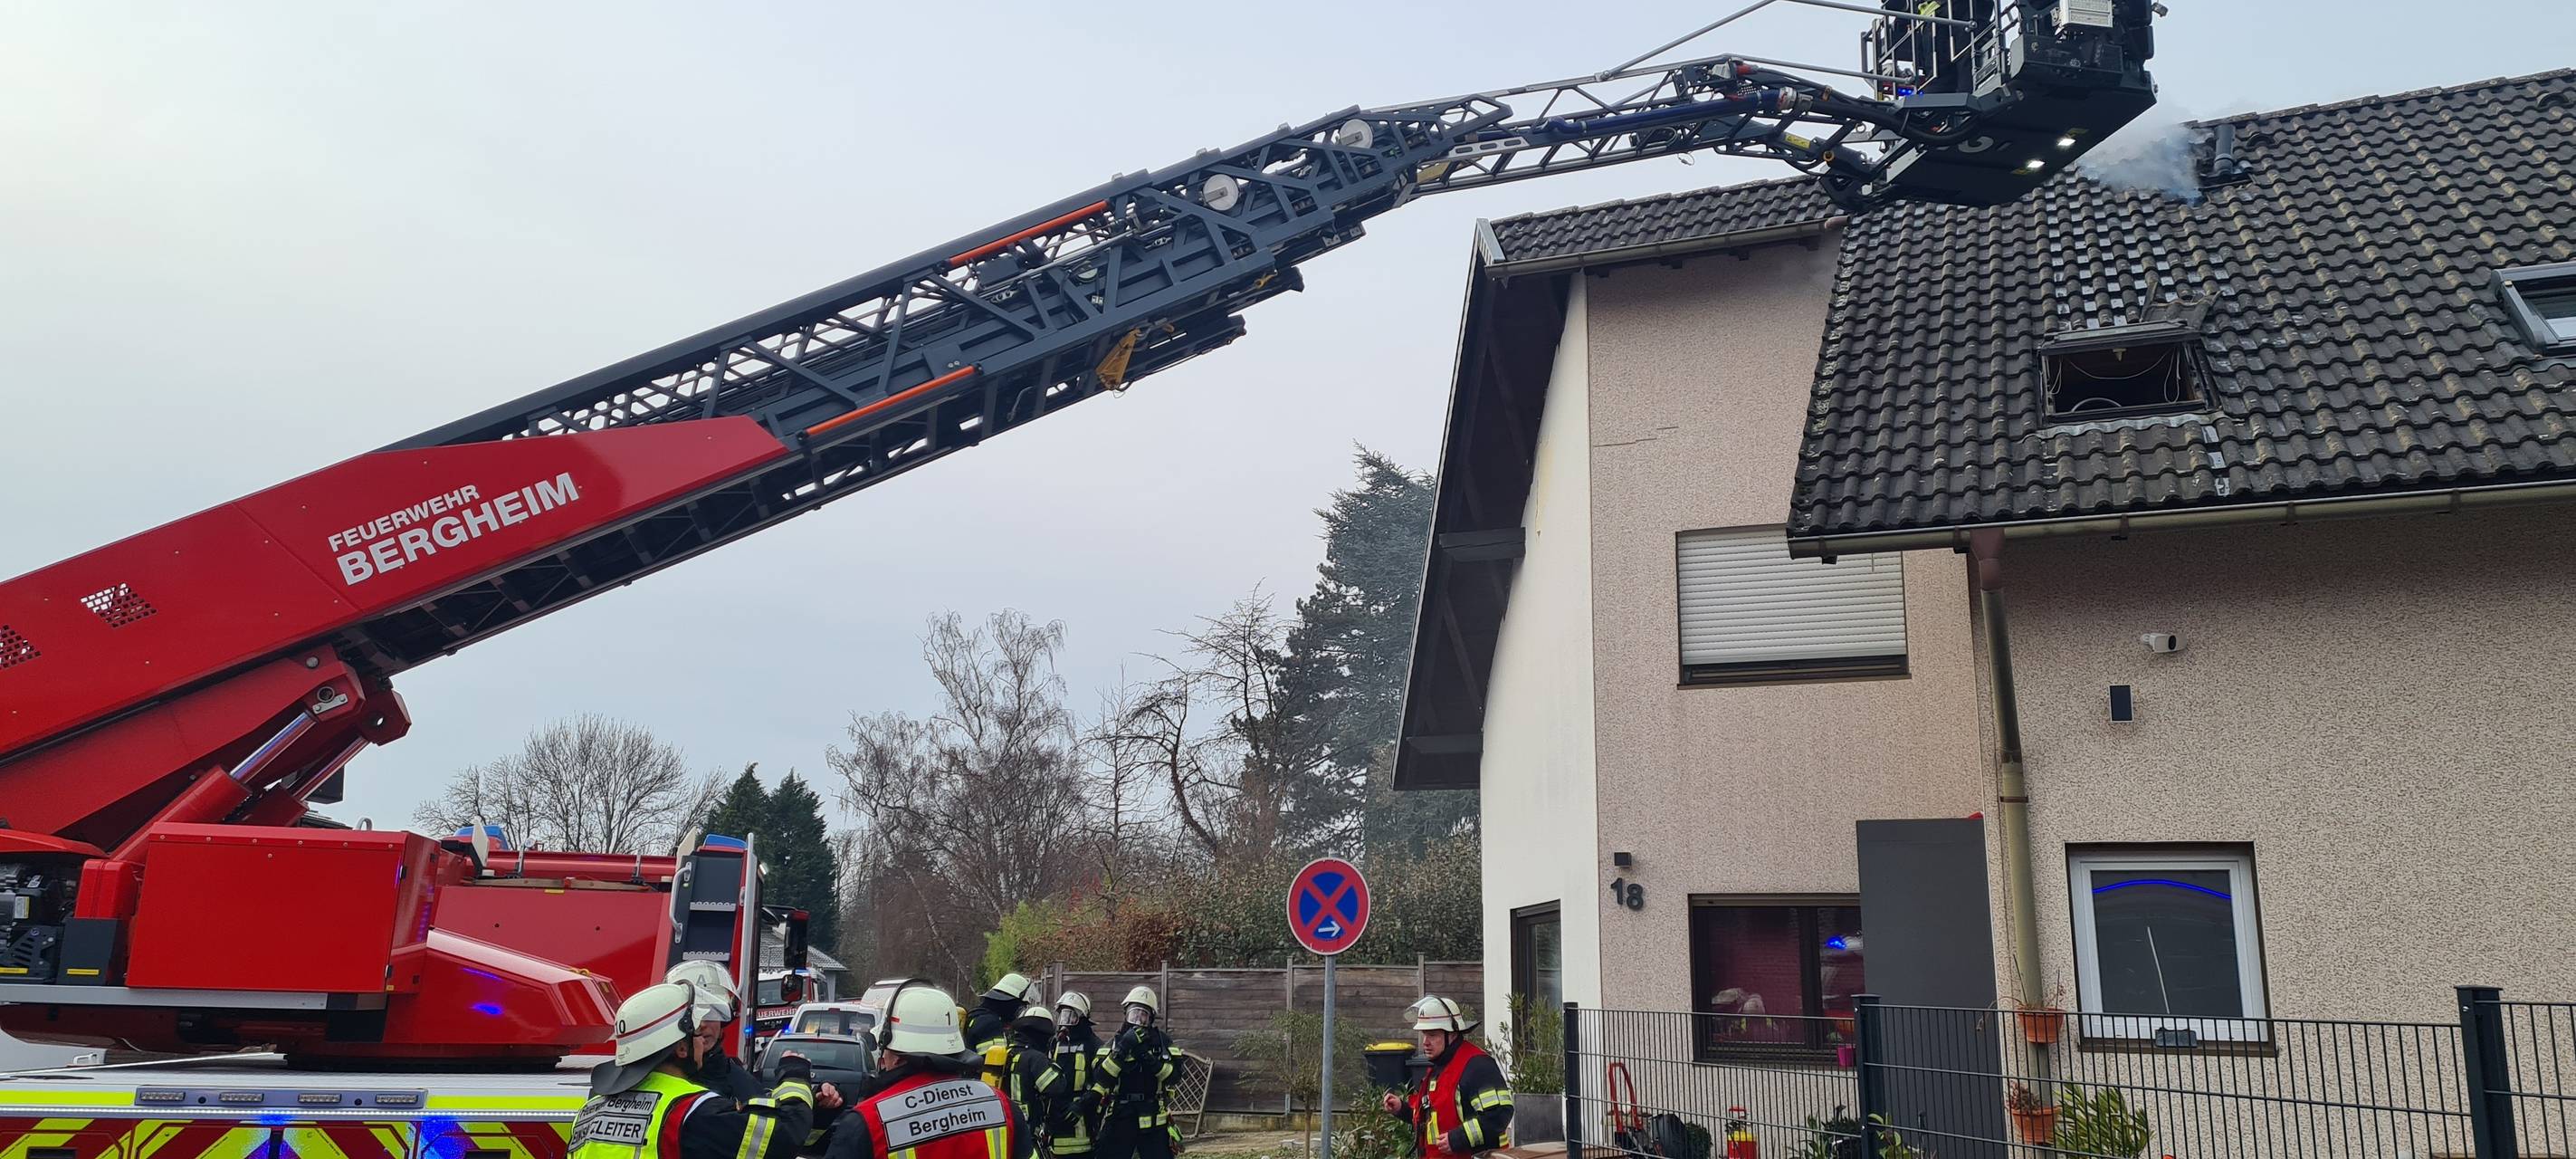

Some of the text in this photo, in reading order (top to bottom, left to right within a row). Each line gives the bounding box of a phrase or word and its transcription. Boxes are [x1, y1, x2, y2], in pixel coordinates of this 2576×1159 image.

[328, 484, 480, 552] FEUERWEHR
[336, 472, 580, 586] BERGHEIM
[1610, 877, 1644, 911] 18
[945, 1011, 951, 1026] 1
[607, 1097, 652, 1112] Bergheim
[905, 1084, 974, 1109] C-Dienst
[909, 1108, 987, 1136] Bergheim
